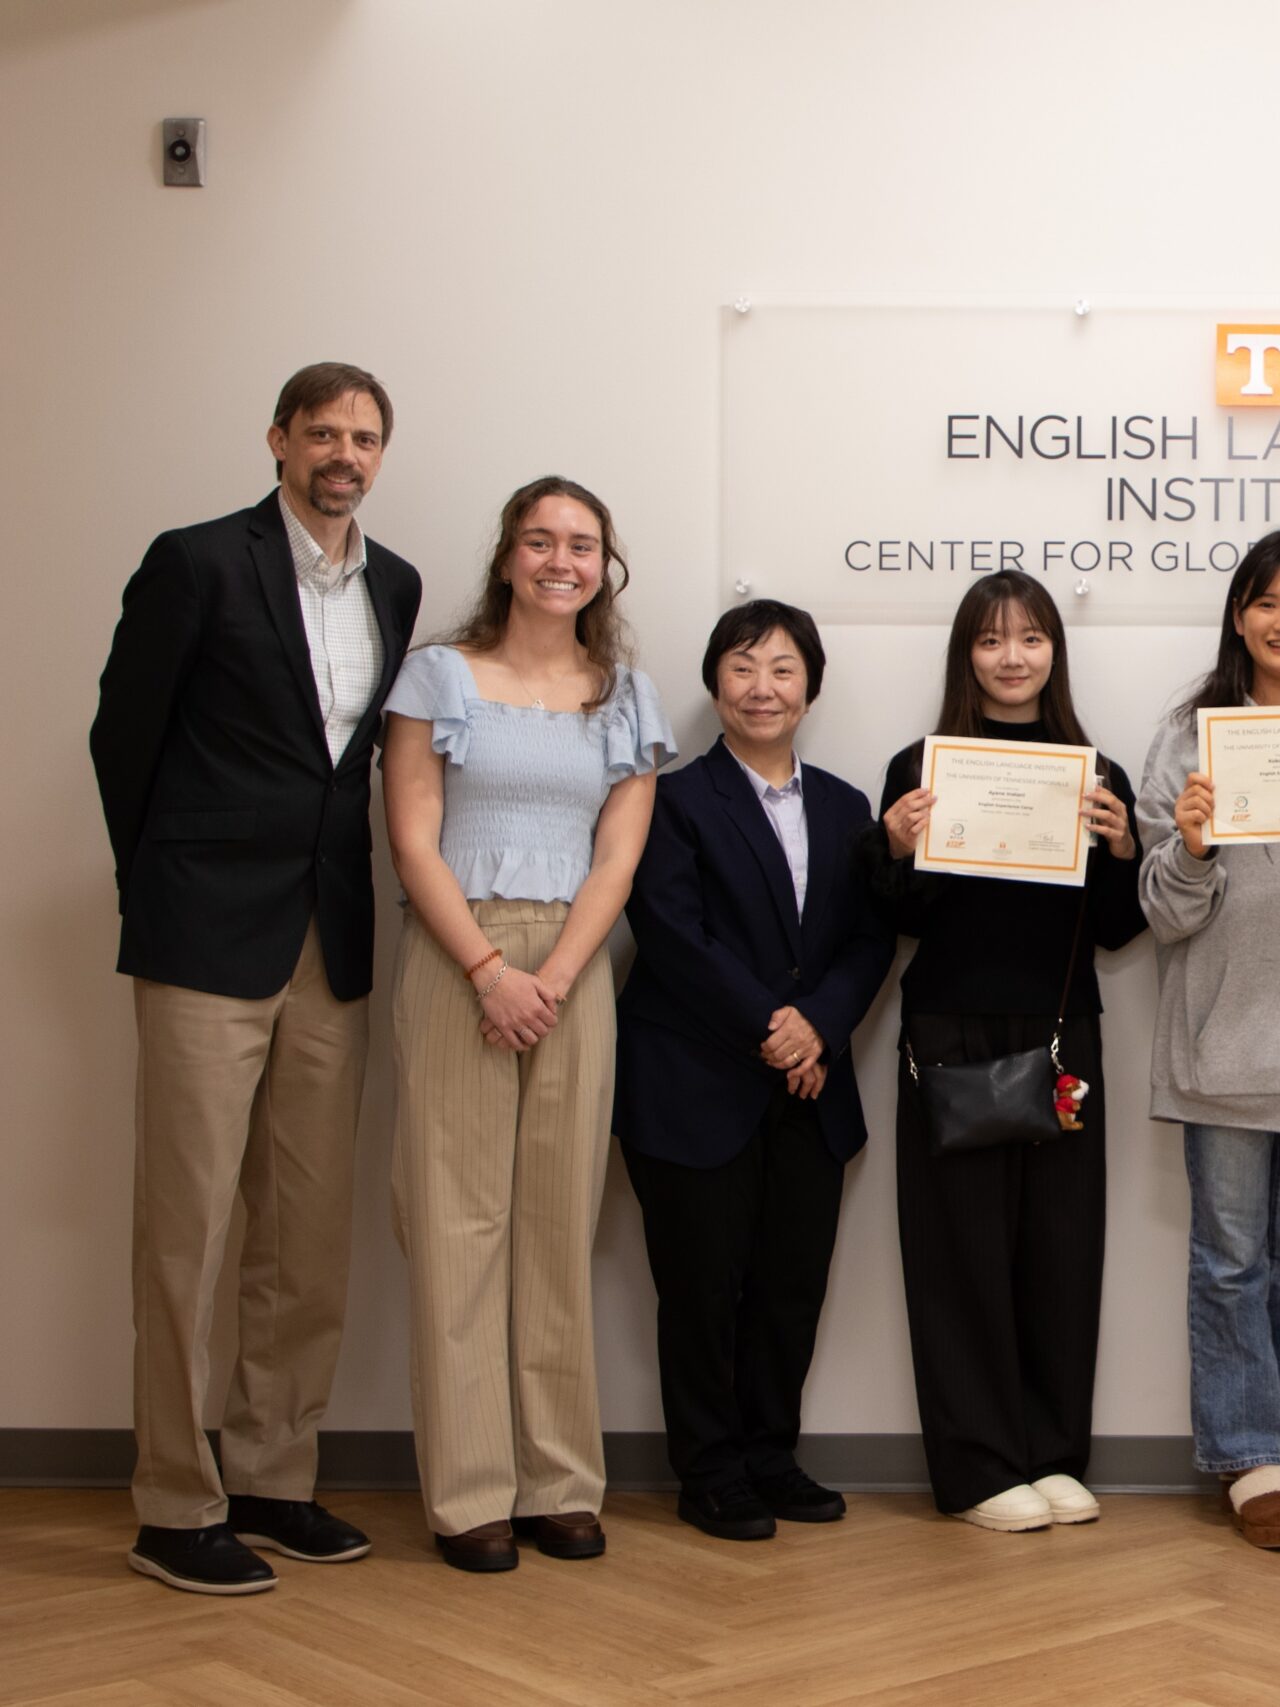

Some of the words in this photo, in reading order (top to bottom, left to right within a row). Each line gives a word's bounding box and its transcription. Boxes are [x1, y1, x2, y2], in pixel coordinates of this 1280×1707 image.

[947, 414, 1197, 460] ENGLISH
[844, 540, 1025, 572] CENTER
[1043, 541, 1133, 572] FOR
[1151, 541, 1254, 572] GLO
[1243, 728, 1272, 736] ENGLISH
[966, 759, 995, 767] ENGLISH
[996, 761, 1032, 770] LANGUAGE
[1034, 764, 1067, 772] INSTITUTE
[959, 774, 992, 782] UNIVERSITY
[1003, 777, 1036, 785] TENNESSEE
